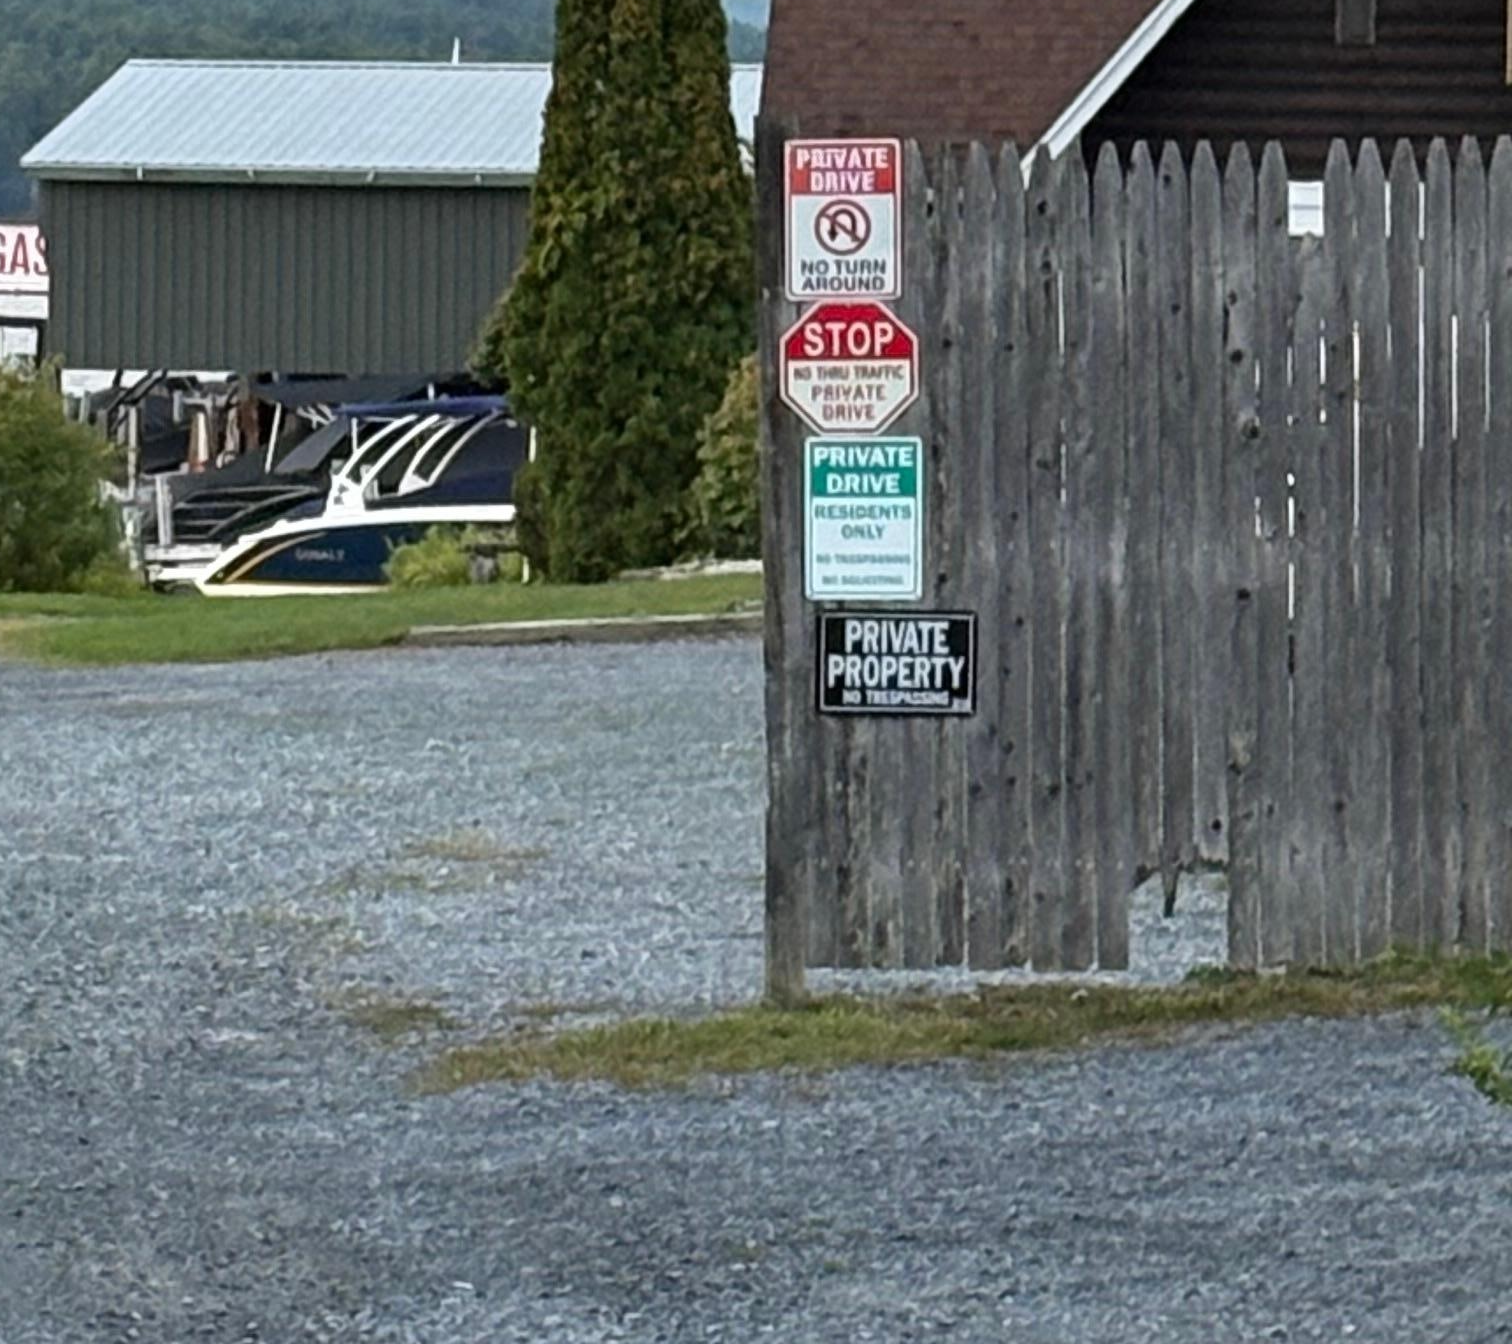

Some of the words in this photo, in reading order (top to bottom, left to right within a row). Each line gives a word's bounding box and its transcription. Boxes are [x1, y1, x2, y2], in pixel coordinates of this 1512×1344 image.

[796, 147, 889, 169] PRIVATE
[810, 170, 875, 192] DRIVE
[800, 259, 829, 275] NO
[834, 259, 886, 275] TURN
[802, 276, 885, 291] AROUND
[803, 321, 894, 356] STOP
[794, 366, 812, 380] NO
[816, 365, 849, 380] THRU
[854, 364, 904, 380] TRAFFIC
[811, 384, 886, 401] PRIVATE
[822, 404, 875, 421] DRIVE
[814, 446, 914, 467] PRIVATE
[826, 473, 900, 494] DRIVE
[815, 504, 911, 520] RESIDENTS
[841, 524, 884, 539] ONLY
[844, 620, 949, 654] PRIVATE
[828, 654, 965, 689] PROPERTY
[842, 689, 861, 704] NO
[865, 689, 948, 705] TRESPASSING
